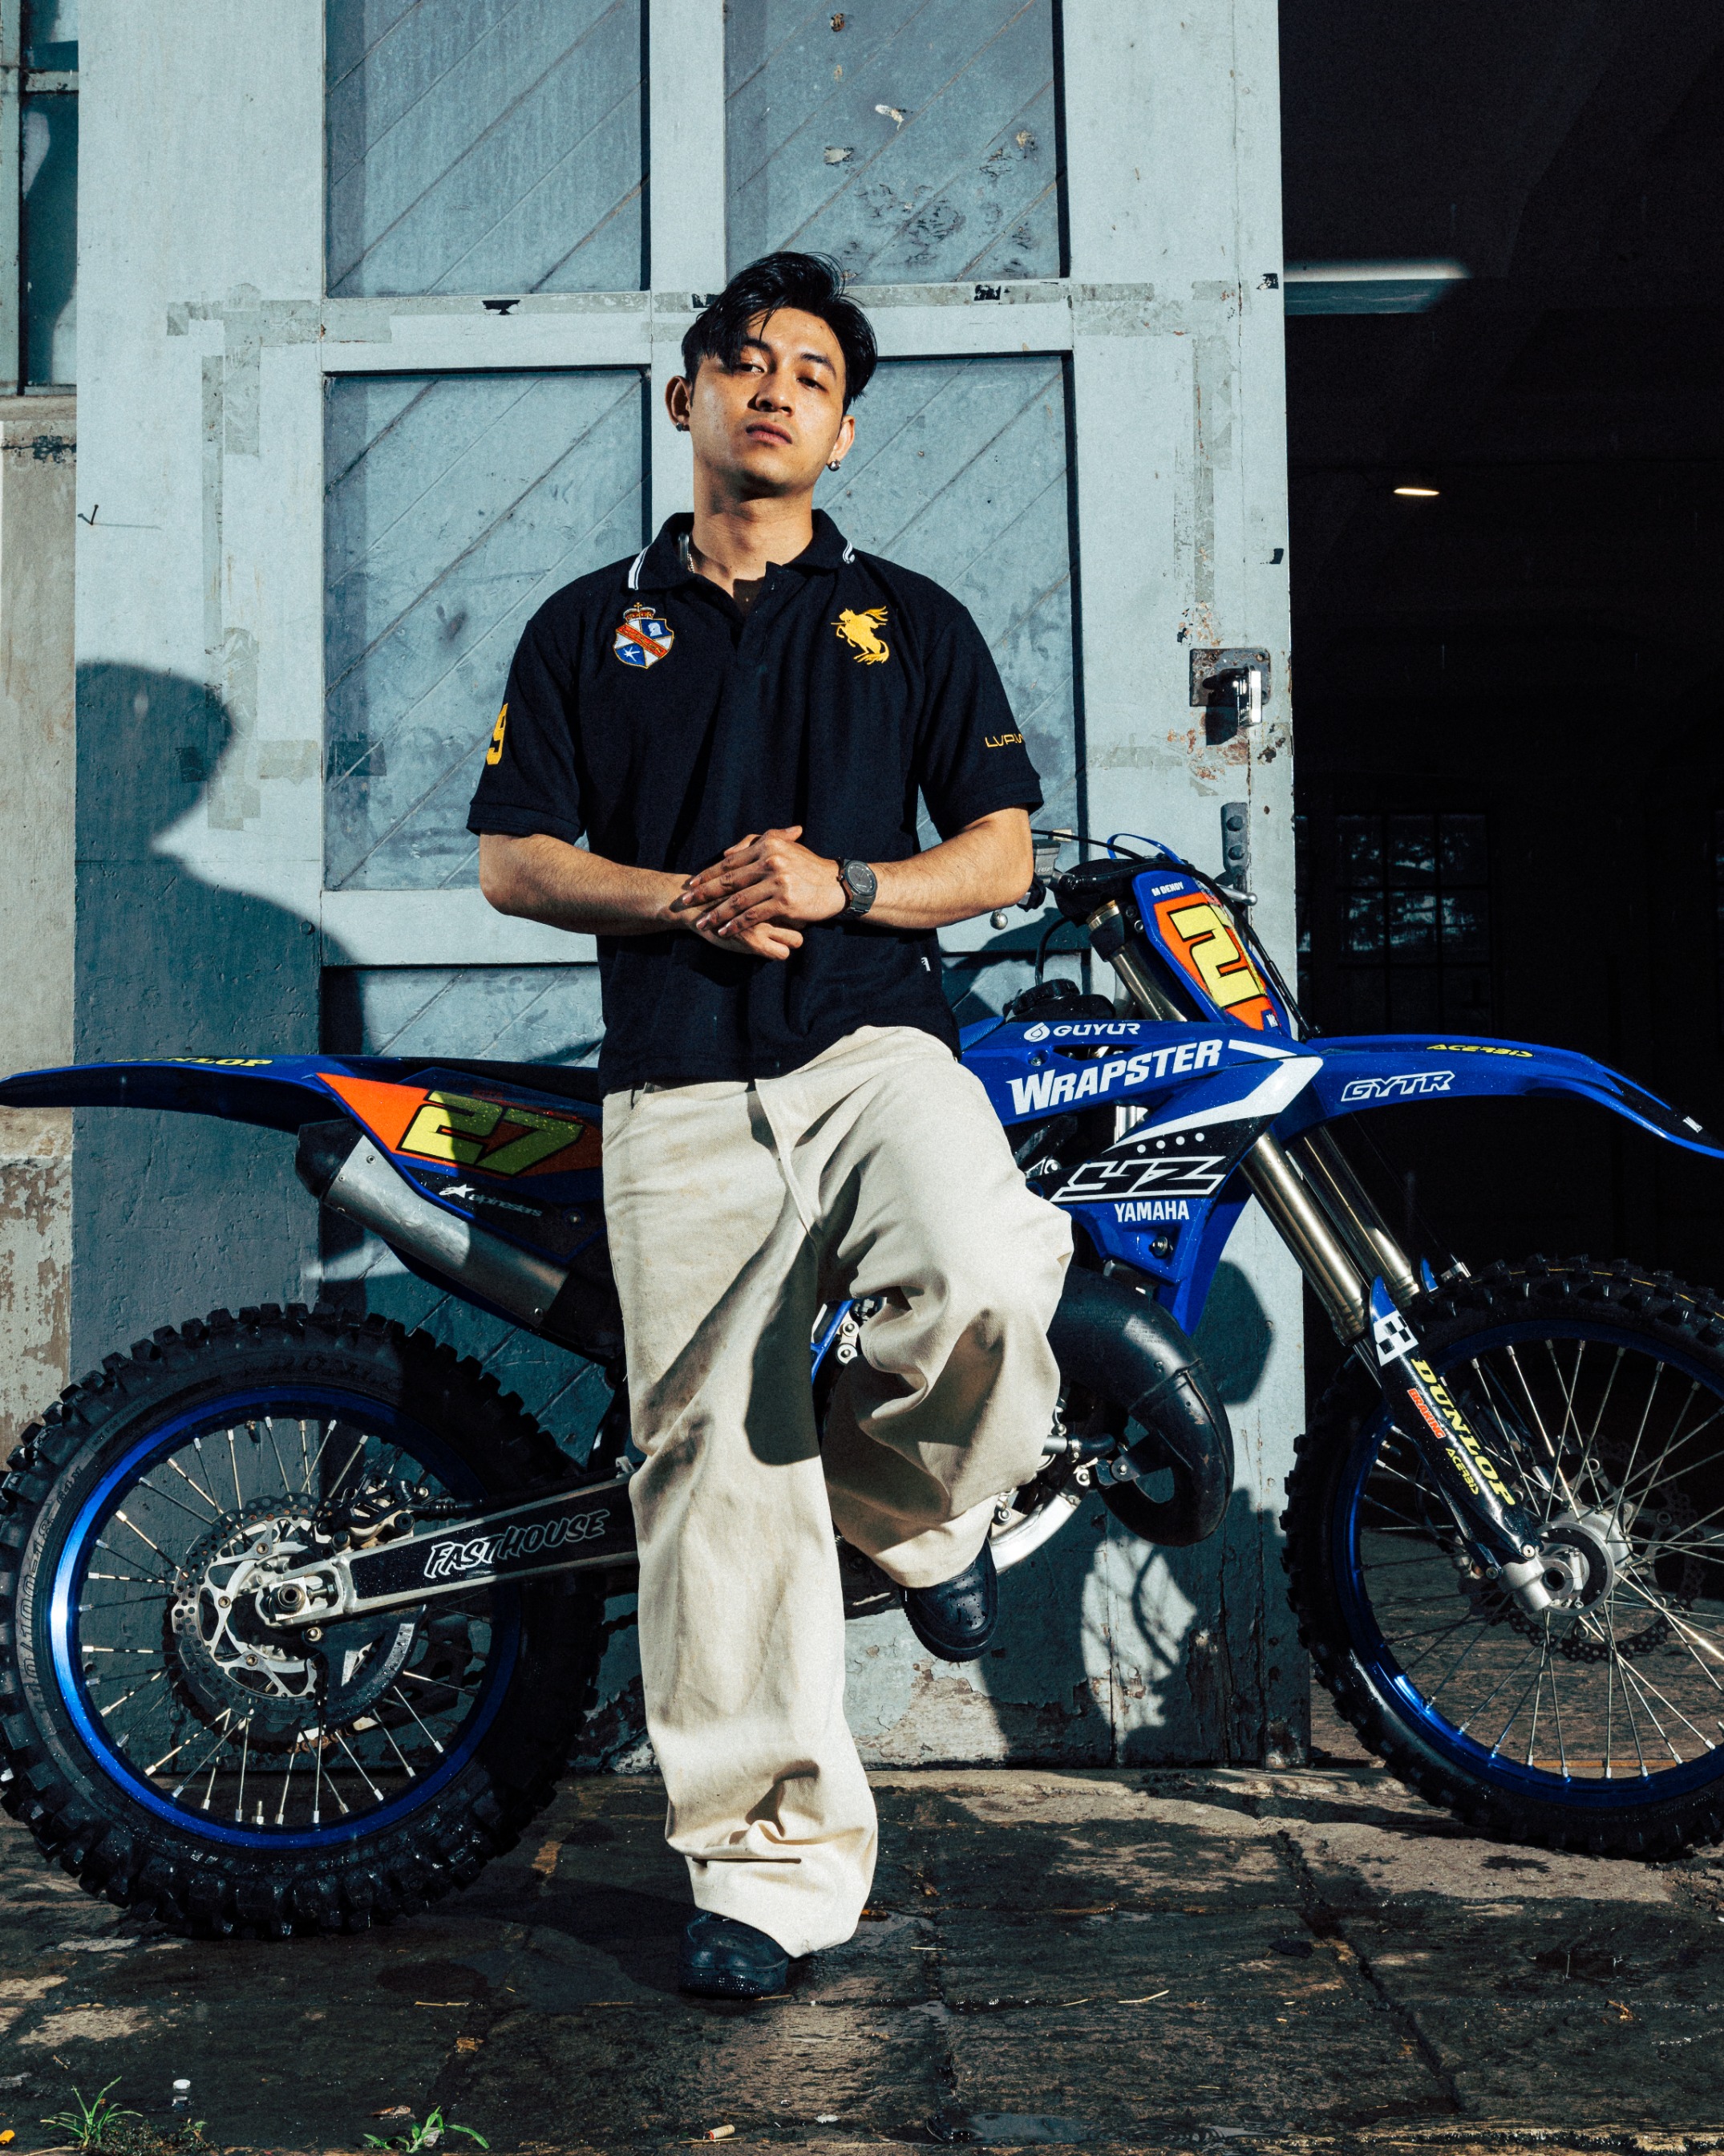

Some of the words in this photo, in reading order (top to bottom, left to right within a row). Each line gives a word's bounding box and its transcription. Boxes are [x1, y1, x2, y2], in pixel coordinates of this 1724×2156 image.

[1167, 902, 1269, 1010] 2
[1053, 1022, 1141, 1036] GUYUR
[1426, 1044, 1534, 1058] ACERBIS
[1006, 1039, 1224, 1116] WRAPSTER
[1340, 1070, 1455, 1103] GYTR
[396, 1089, 586, 1177] 27
[1114, 1200, 1190, 1223] YAMAHA
[1406, 1387, 1447, 1440] BRAKING
[1410, 1358, 1516, 1506] DUNLOP
[1446, 1446, 1480, 1496] ACERBIS
[423, 1508, 612, 1579] FASTHOUSE
